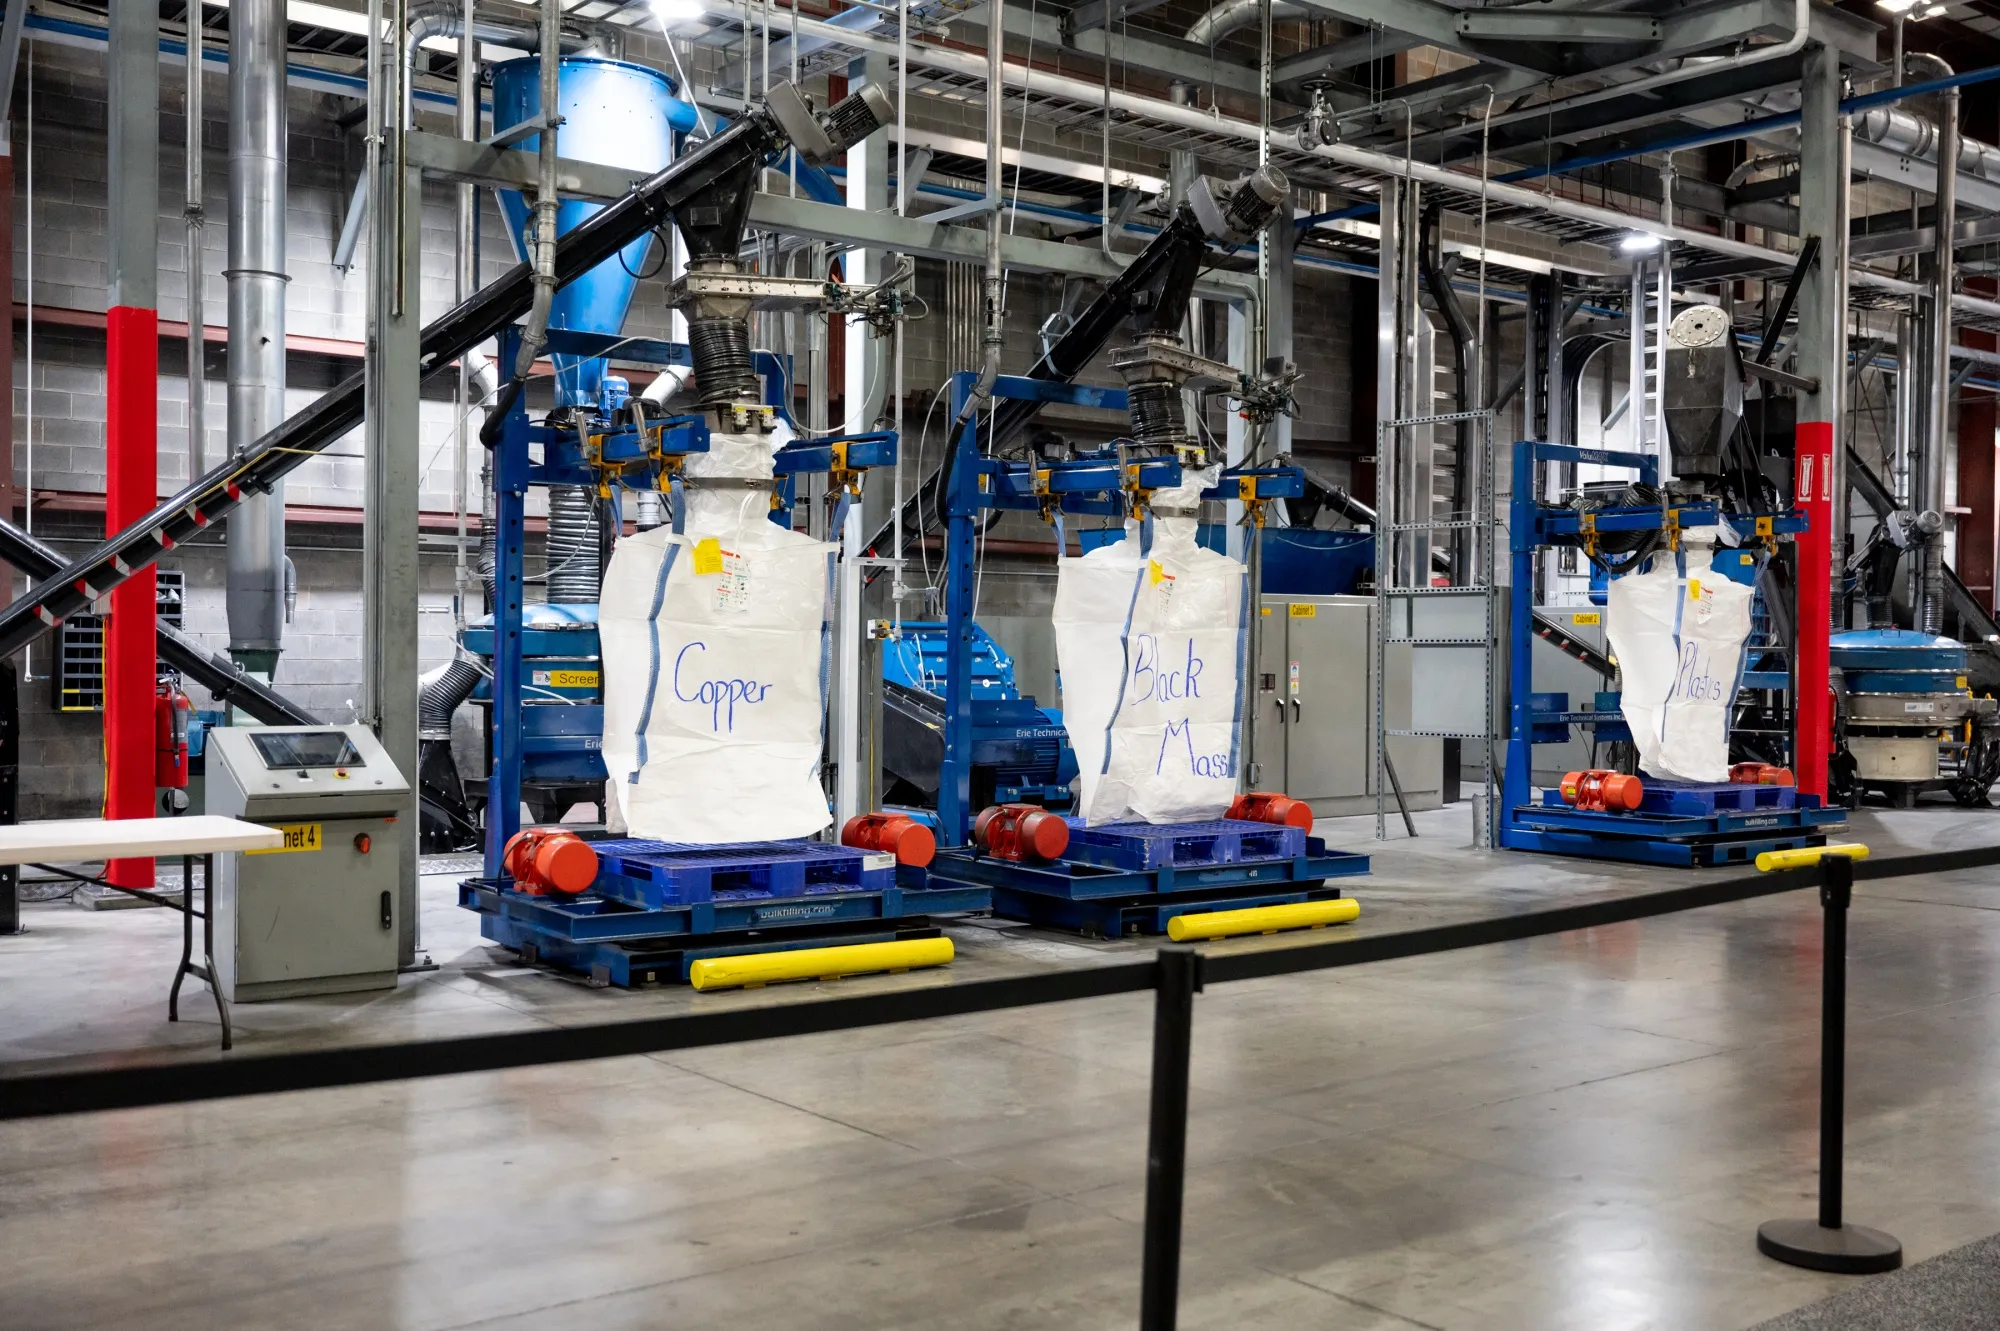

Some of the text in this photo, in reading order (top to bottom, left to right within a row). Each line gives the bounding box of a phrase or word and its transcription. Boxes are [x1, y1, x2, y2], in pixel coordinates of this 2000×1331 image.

[1292, 604, 1309, 616] Cabinet
[1576, 614, 1597, 623] Cabinet 2
[1131, 633, 1203, 706] Black
[1676, 640, 1721, 701] Plastics
[674, 641, 773, 733] Copper
[1559, 714, 1570, 722] Erie
[1593, 714, 1612, 722] Systems
[1015, 728, 1068, 738] Erie Technica
[1156, 717, 1228, 779] Mass
[1744, 818, 1778, 827] bulkfilling.com
[307, 825, 316, 847] 4
